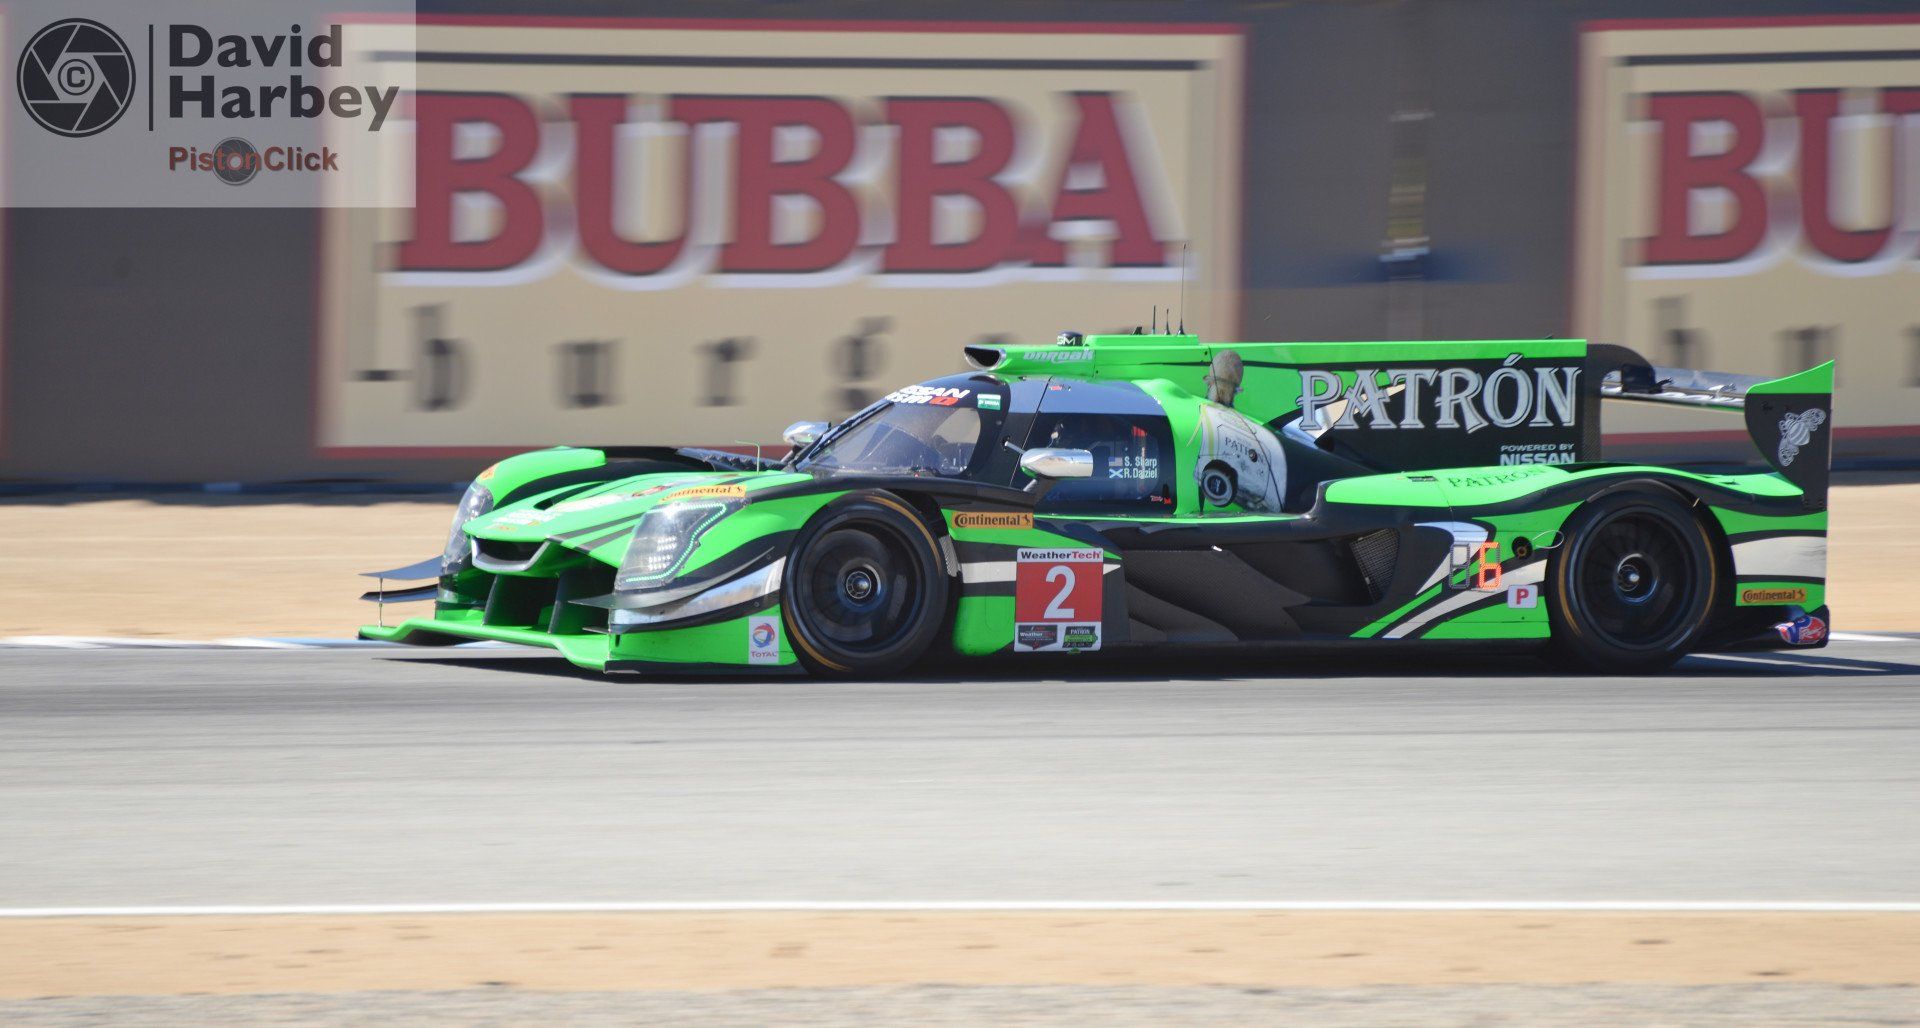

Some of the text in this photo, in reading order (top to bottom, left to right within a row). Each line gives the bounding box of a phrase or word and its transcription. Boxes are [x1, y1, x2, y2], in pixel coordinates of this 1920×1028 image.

[394, 92, 1172, 276] BUBBA
[1295, 352, 1582, 434] PATRÓN
[1500, 443, 1575, 452] POWERED BY
[1124, 456, 1133, 467] S.
[1500, 452, 1576, 466] NISSAN
[1124, 469, 1132, 479] R.
[954, 513, 1020, 528] Continental
[1020, 551, 1100, 559] WeatherTech
[1044, 565, 1076, 619] 2
[1516, 588, 1529, 605] P
[1743, 590, 1796, 603] Continental
